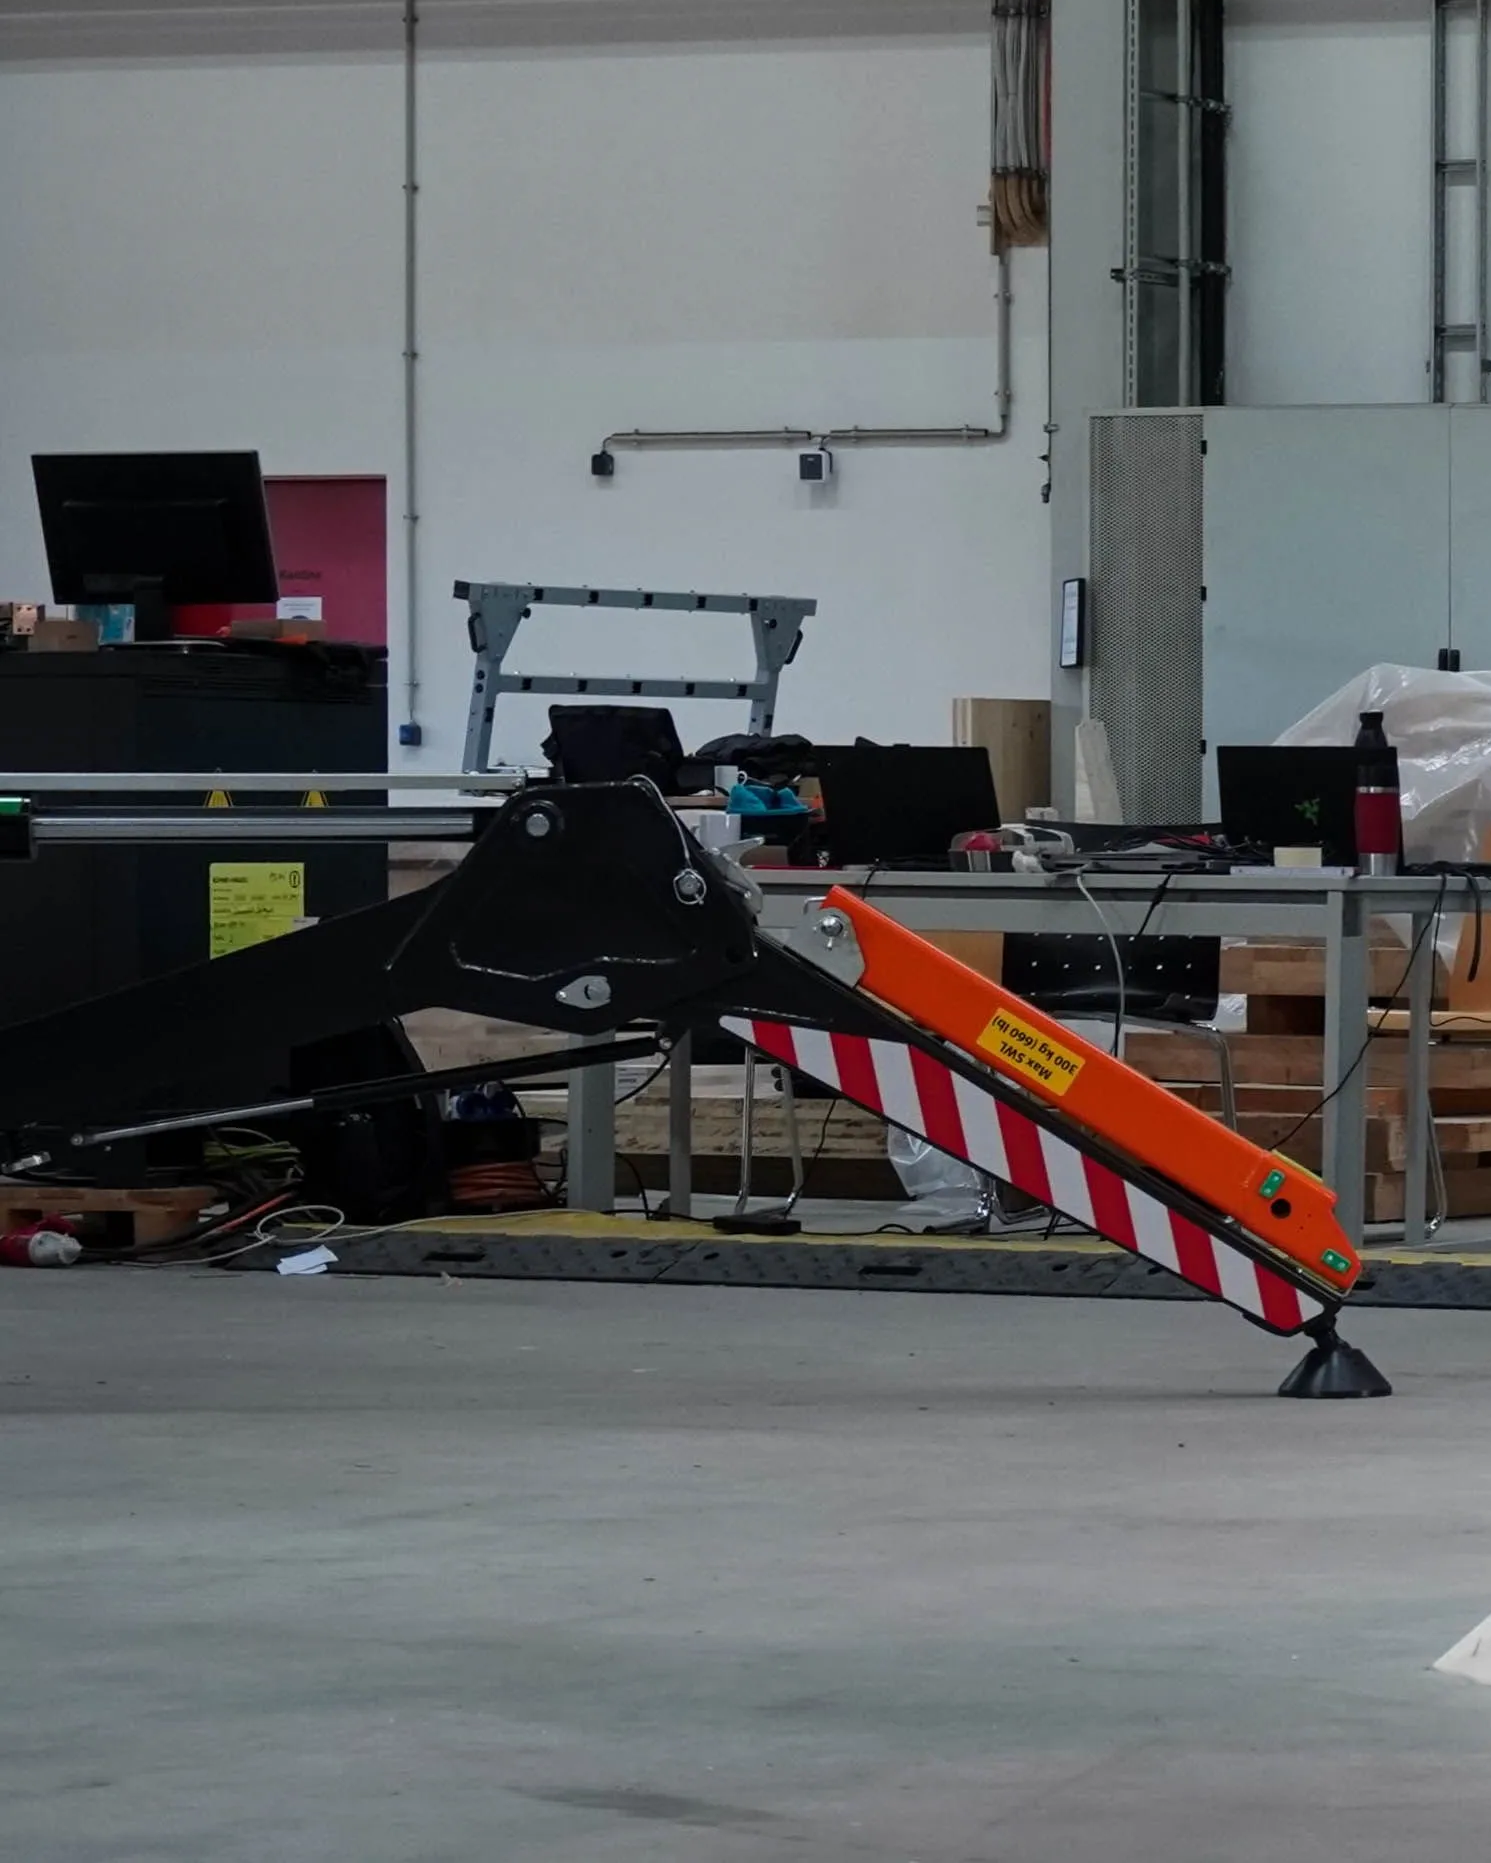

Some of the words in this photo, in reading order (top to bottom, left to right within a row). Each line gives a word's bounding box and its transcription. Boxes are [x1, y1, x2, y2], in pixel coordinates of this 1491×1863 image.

[991, 1016, 1010, 1033] lb)
[1008, 1027, 1038, 1050] (660
[1000, 1040, 1027, 1063] SWL
[1038, 1042, 1054, 1061] kg
[1026, 1058, 1053, 1080] Max
[1054, 1055, 1079, 1076] 300
